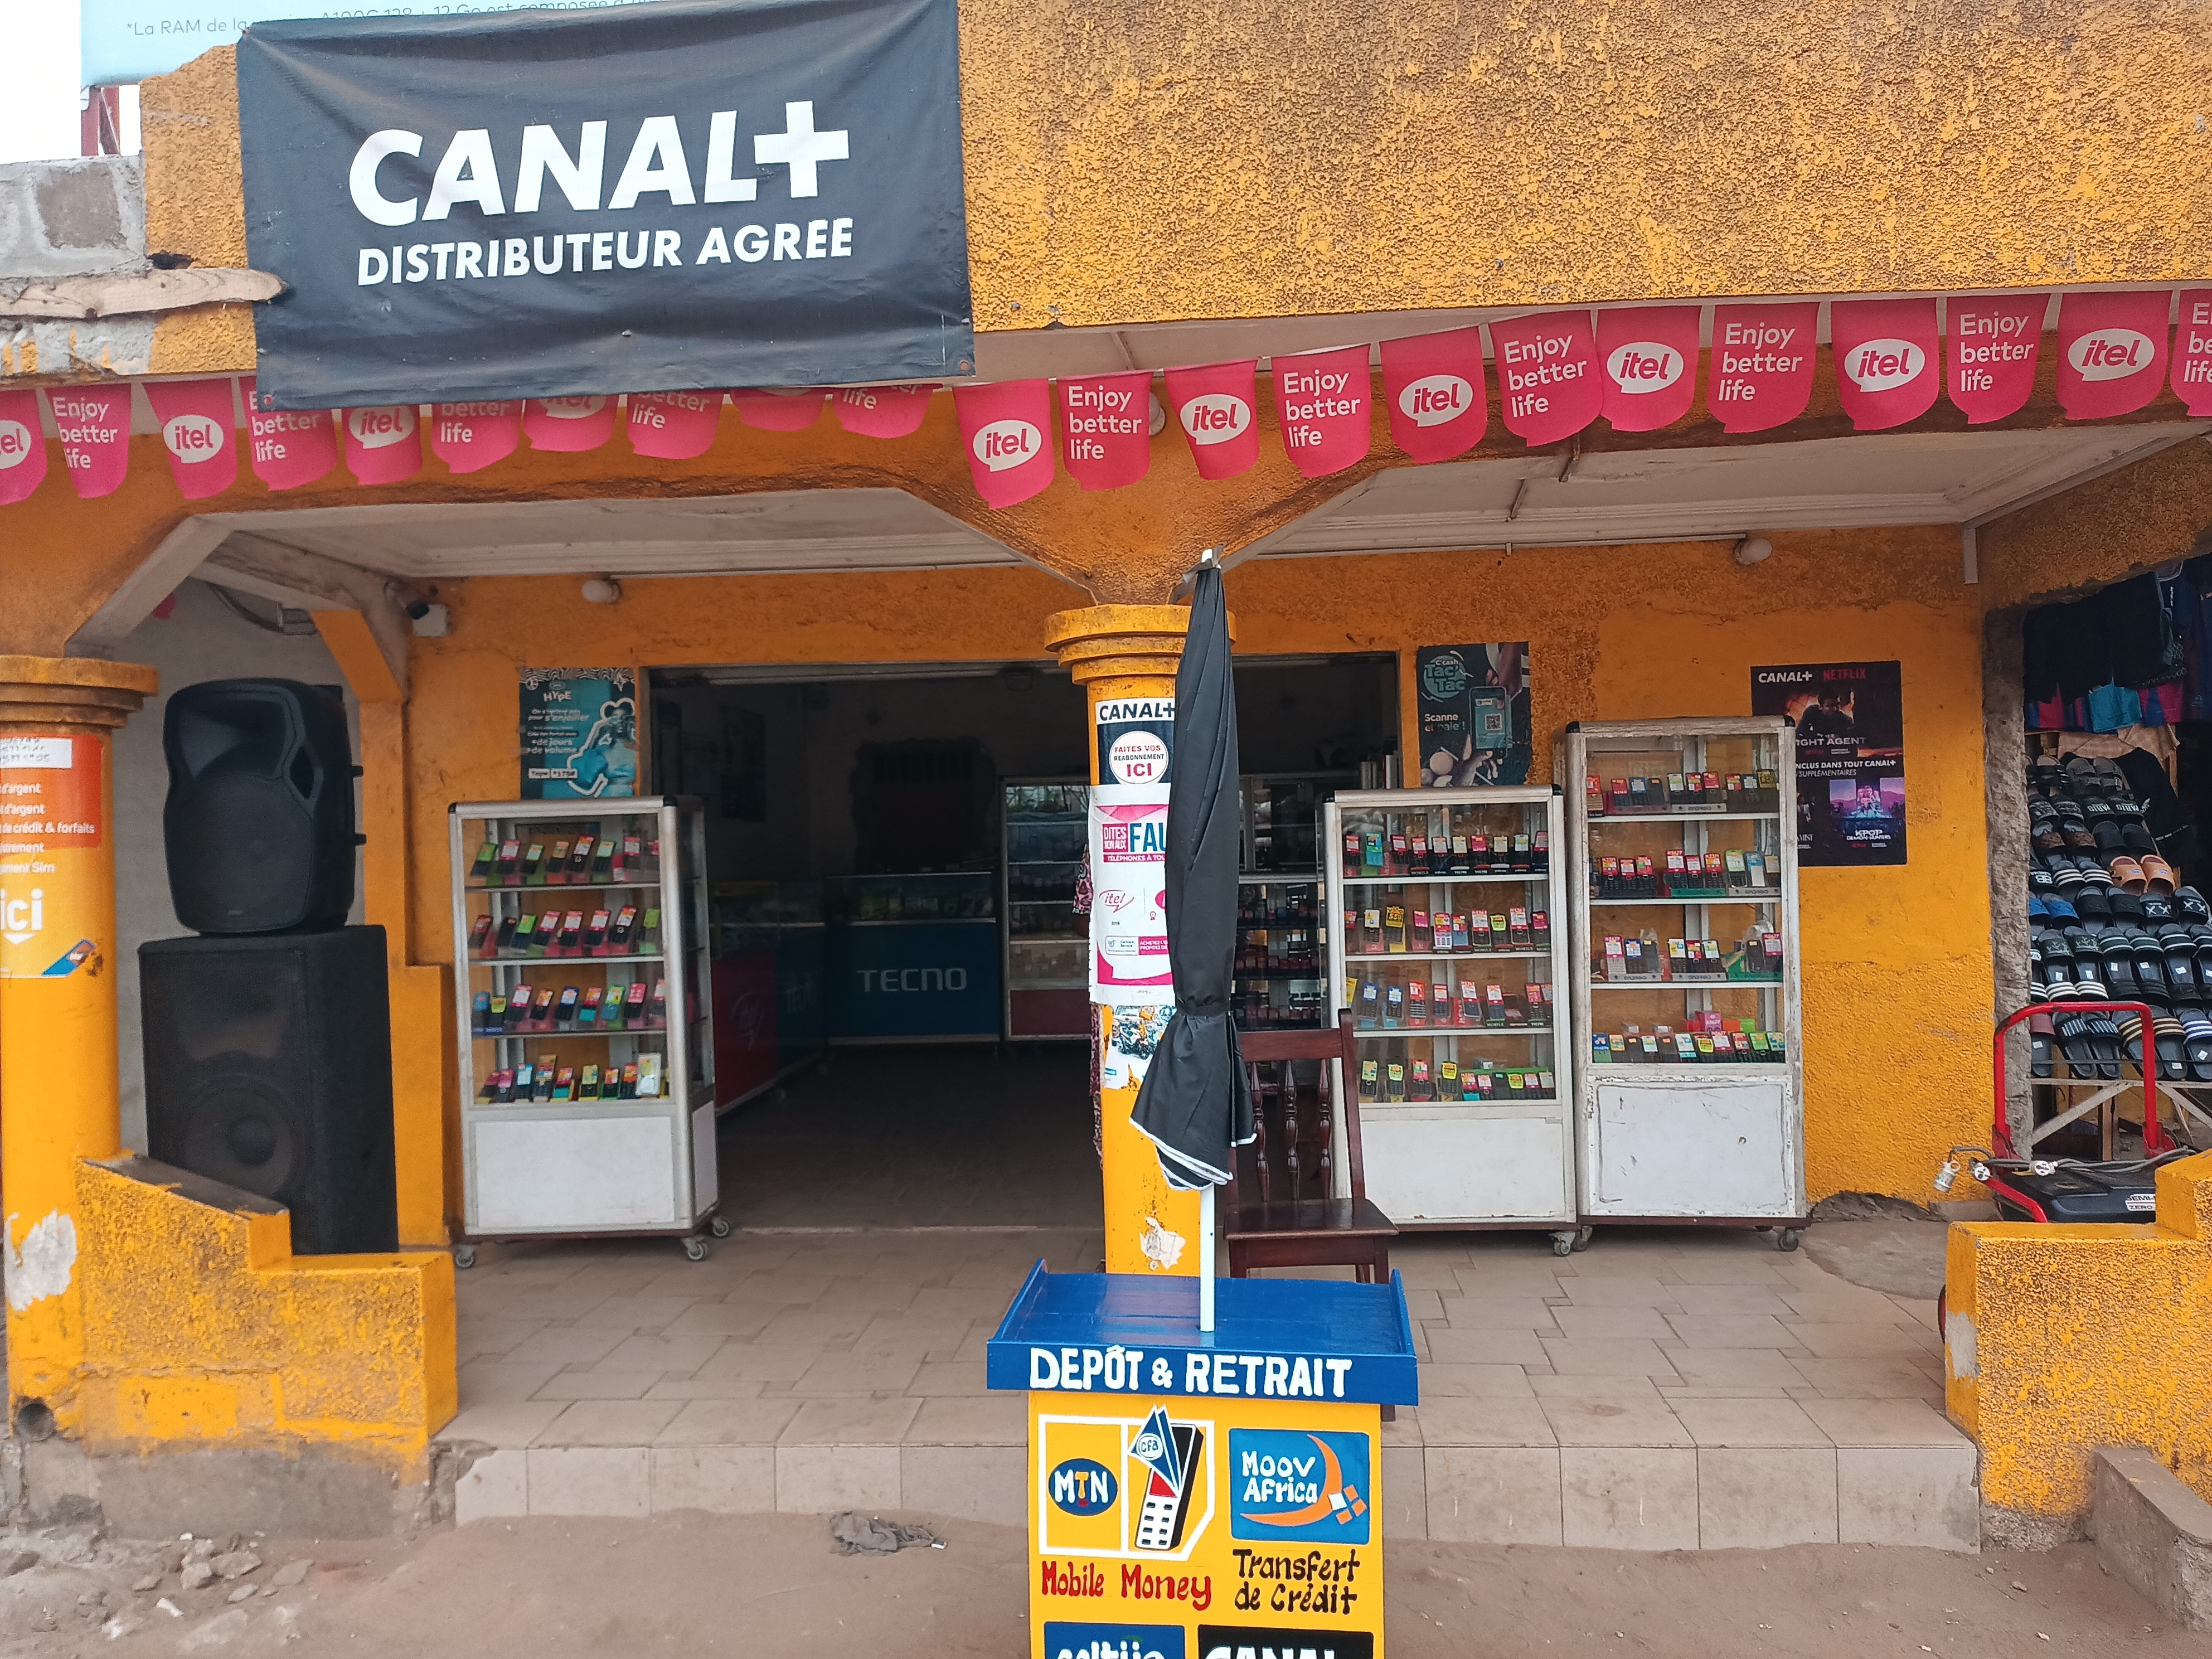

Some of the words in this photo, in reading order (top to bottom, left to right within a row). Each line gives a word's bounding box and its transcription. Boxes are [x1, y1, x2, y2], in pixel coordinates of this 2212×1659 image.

[161, 20, 201, 34] RAM
[207, 18, 227, 32] de
[348, 100, 850, 226] CANAL+
[357, 229, 682, 286] DISTRIBUTEUR
[696, 217, 853, 265] AGREE
[1725, 322, 1796, 350] Enjoy
[1959, 311, 2030, 339] Enjoy
[1503, 334, 1573, 364] Enjoy
[1960, 341, 2034, 364] better
[2082, 339, 2142, 367] itel
[1619, 352, 1670, 380] itel
[1722, 350, 1803, 374] better
[1857, 348, 1910, 378] itel
[1283, 368, 1350, 395] Enjoy
[1508, 361, 1588, 391] better
[1960, 369, 1993, 391] life
[843, 387, 877, 409] life
[1068, 385, 1132, 412] Enjoy
[1412, 383, 1461, 414] itel
[1718, 379, 1756, 401] life
[54, 396, 109, 425] Enjoy
[632, 404, 666, 429] life
[1192, 404, 1238, 431] itel
[1286, 396, 1361, 421] better
[1511, 393, 1549, 418] life
[58, 422, 118, 443] better
[251, 413, 318, 435] better
[360, 409, 402, 435] itel
[440, 422, 473, 443] life
[1069, 413, 1142, 434] better
[0, 428, 24, 454] el
[174, 424, 213, 450] itel
[985, 429, 1030, 458] itel
[1070, 439, 1104, 460] life
[1288, 426, 1322, 448] life
[65, 448, 91, 469] life
[255, 440, 287, 463] life
[1435, 678, 1465, 691] Tac
[1758, 671, 1812, 683] CANAL+
[1823, 668, 1866, 681] NETFLIX
[1099, 702, 1175, 721] CANAL+
[1424, 714, 1458, 722] Scanne
[1826, 737, 1866, 746] AGENT
[1127, 763, 1152, 777] ICI
[57, 821, 95, 833] forfaits
[1104, 827, 1127, 840] DITES
[1129, 822, 1167, 852] FAU
[1104, 892, 1126, 904] itel
[855, 967, 967, 992] TECNO
[1029, 1345, 1144, 1391] DEPÔT
[1151, 1357, 1173, 1389] &
[1185, 1353, 1352, 1398] RETRAIT
[1055, 1469, 1109, 1503] MTN
[1041, 1561, 1104, 1597] Mobile
[1121, 1564, 1212, 1611] Money
[1234, 1581, 1260, 1611] de
[1271, 1583, 1357, 1615] Crédit
